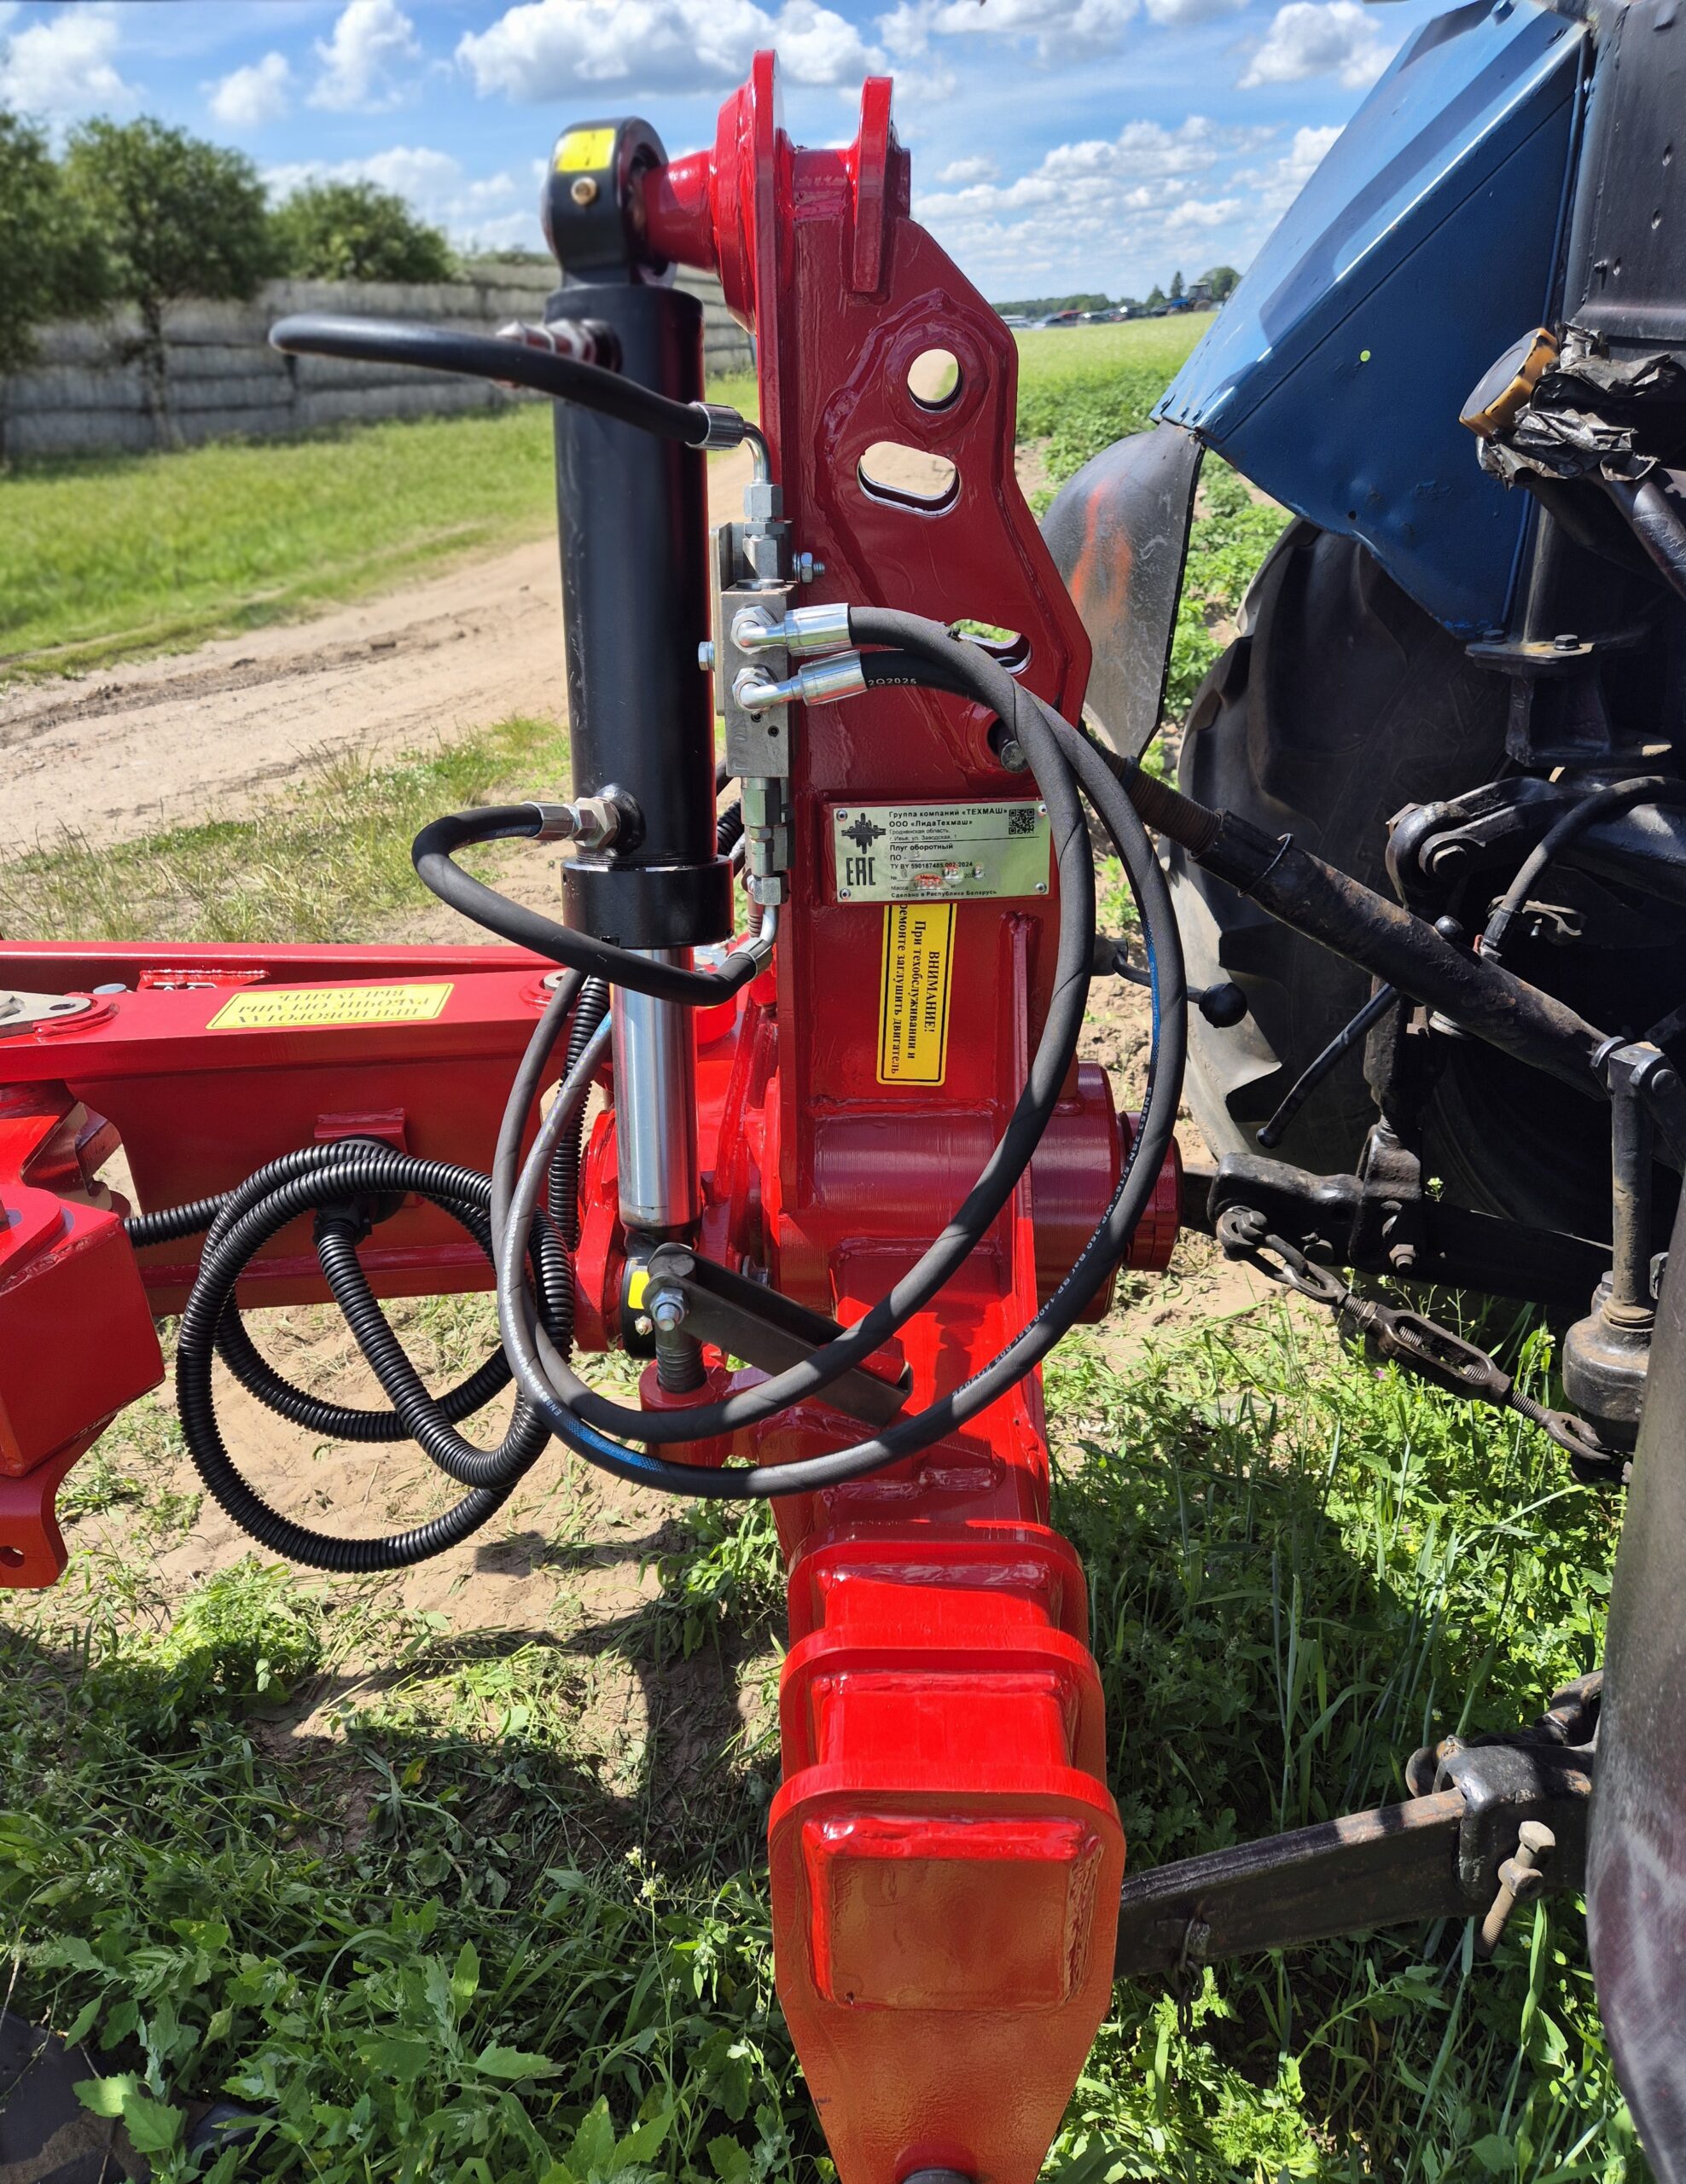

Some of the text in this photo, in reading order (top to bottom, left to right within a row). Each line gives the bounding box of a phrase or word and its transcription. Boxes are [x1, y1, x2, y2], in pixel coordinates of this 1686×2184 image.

[868, 677, 917, 686] 2Q2025
[910, 819, 973, 828] «ЛидаТехмаш»
[910, 843, 954, 851] оборотный
[911, 921, 926, 945] При
[893, 955, 904, 1015] заглушить
[924, 951, 940, 1032] ВНИМАНИЕ!
[908, 949, 922, 1048] техобслуживании
[891, 1018, 901, 1074] двигатель
[1072, 1252, 1086, 1275] Bar
[539, 1391, 562, 1416] EN853
